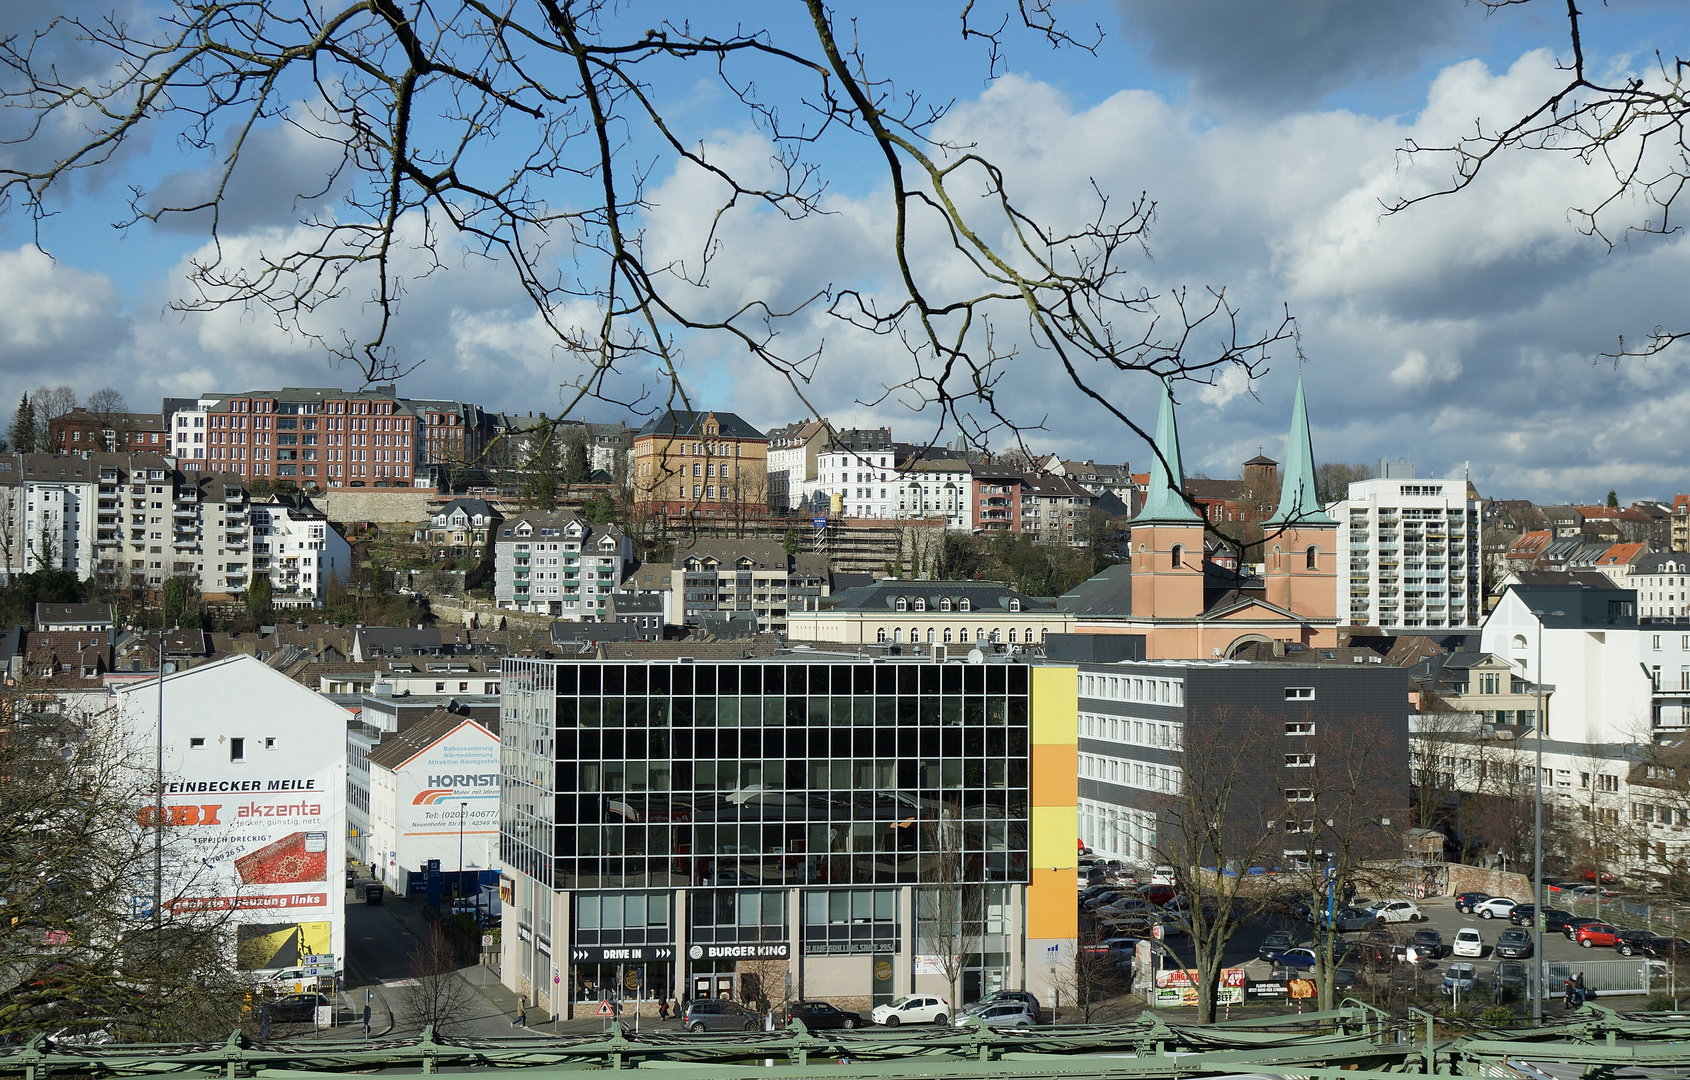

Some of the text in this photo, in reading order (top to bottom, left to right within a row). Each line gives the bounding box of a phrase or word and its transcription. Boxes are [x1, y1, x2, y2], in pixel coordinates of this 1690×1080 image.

[267, 779, 315, 790] MEILE
[138, 801, 321, 827] OBI akzenta
[442, 811, 469, 819] (0202)
[267, 817, 301, 826] günstig,
[303, 817, 321, 825] nett
[193, 836, 227, 844] TEPPICH
[226, 848, 235, 858] 26
[236, 844, 246, 854] 53
[291, 895, 320, 905] links
[708, 945, 787, 957] BURGER KING
[806, 945, 826, 953] FLAME
[827, 944, 858, 952] GRILLING
[859, 944, 878, 952] SINCE
[603, 949, 641, 959] DRIVE IN
